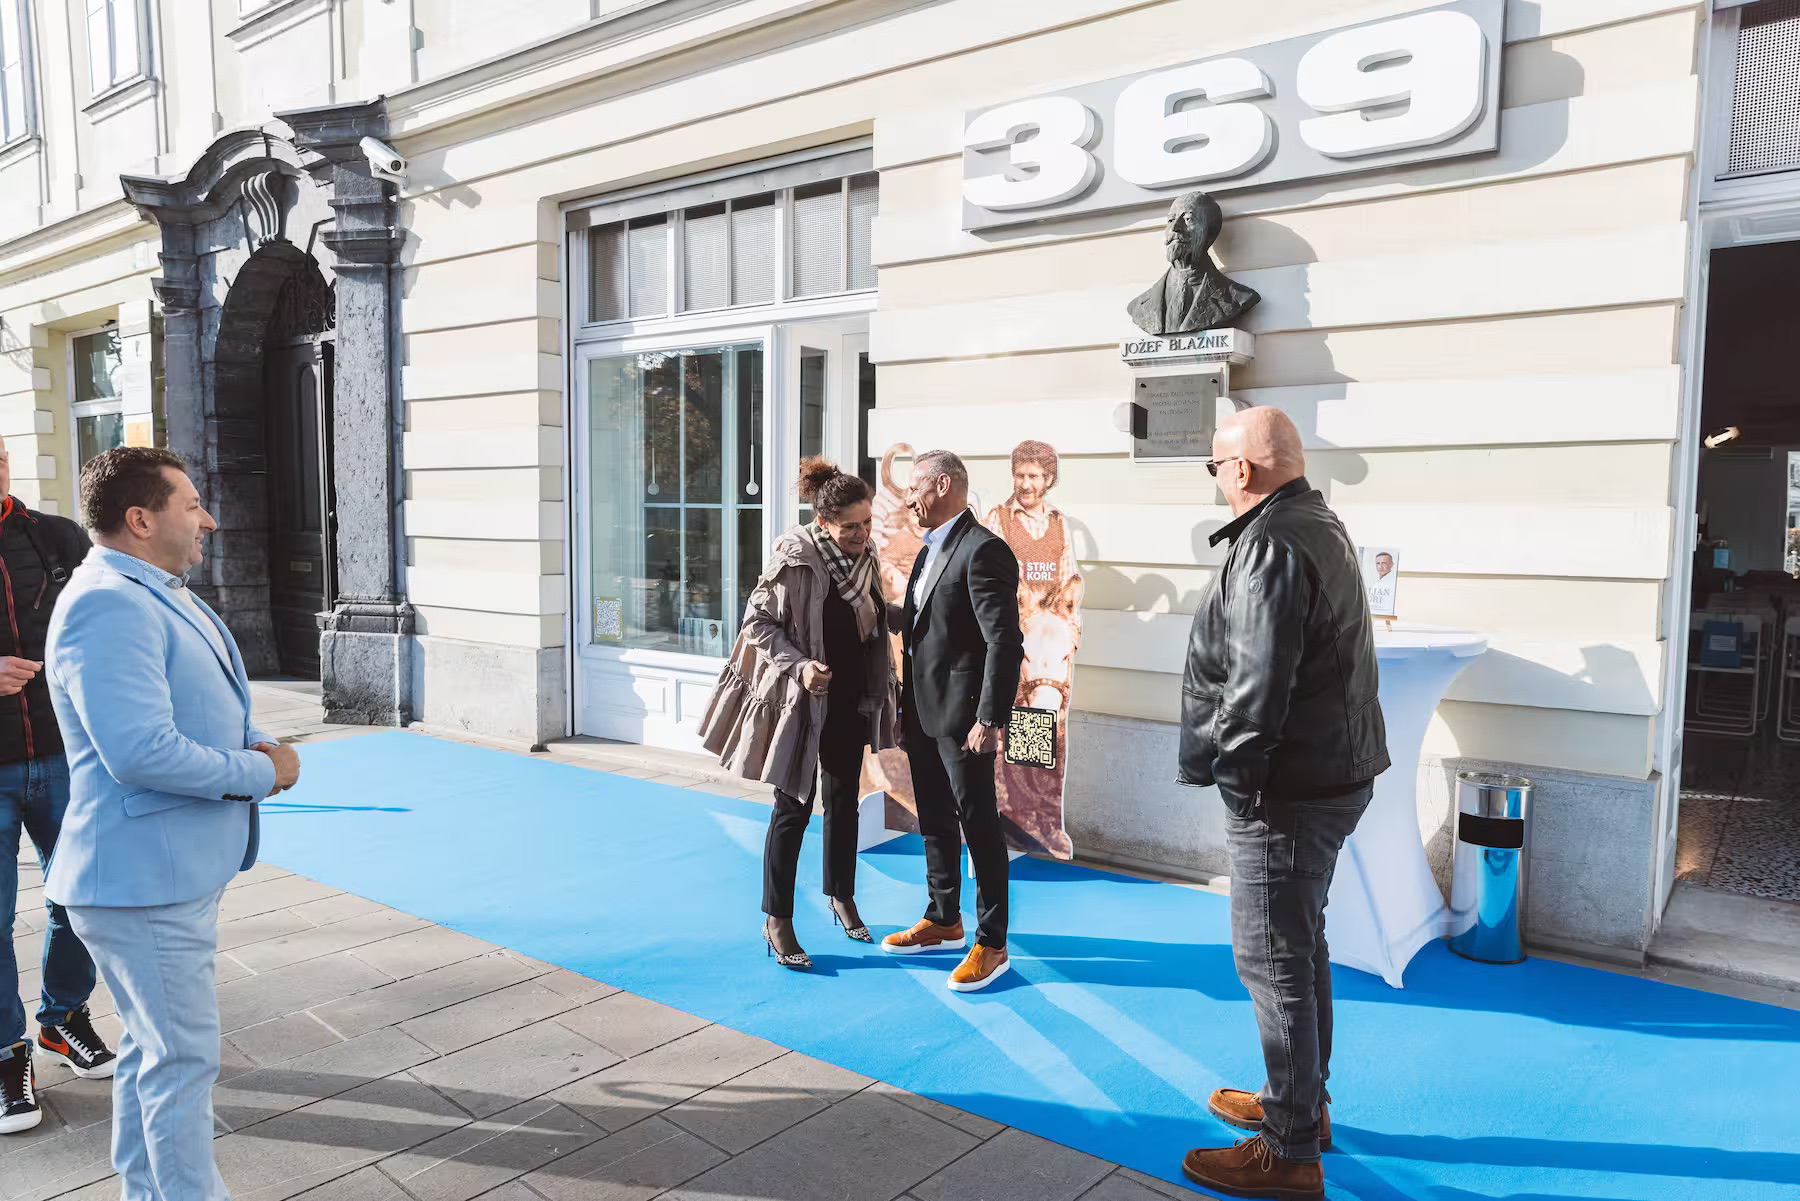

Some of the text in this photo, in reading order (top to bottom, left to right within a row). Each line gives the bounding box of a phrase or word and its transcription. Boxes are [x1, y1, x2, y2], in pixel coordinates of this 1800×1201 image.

[962, 10, 1488, 211] 369
[1122, 338, 1164, 357] JOŽEF
[1027, 562, 1056, 571] STRIC
[1027, 572, 1054, 580] KORL
